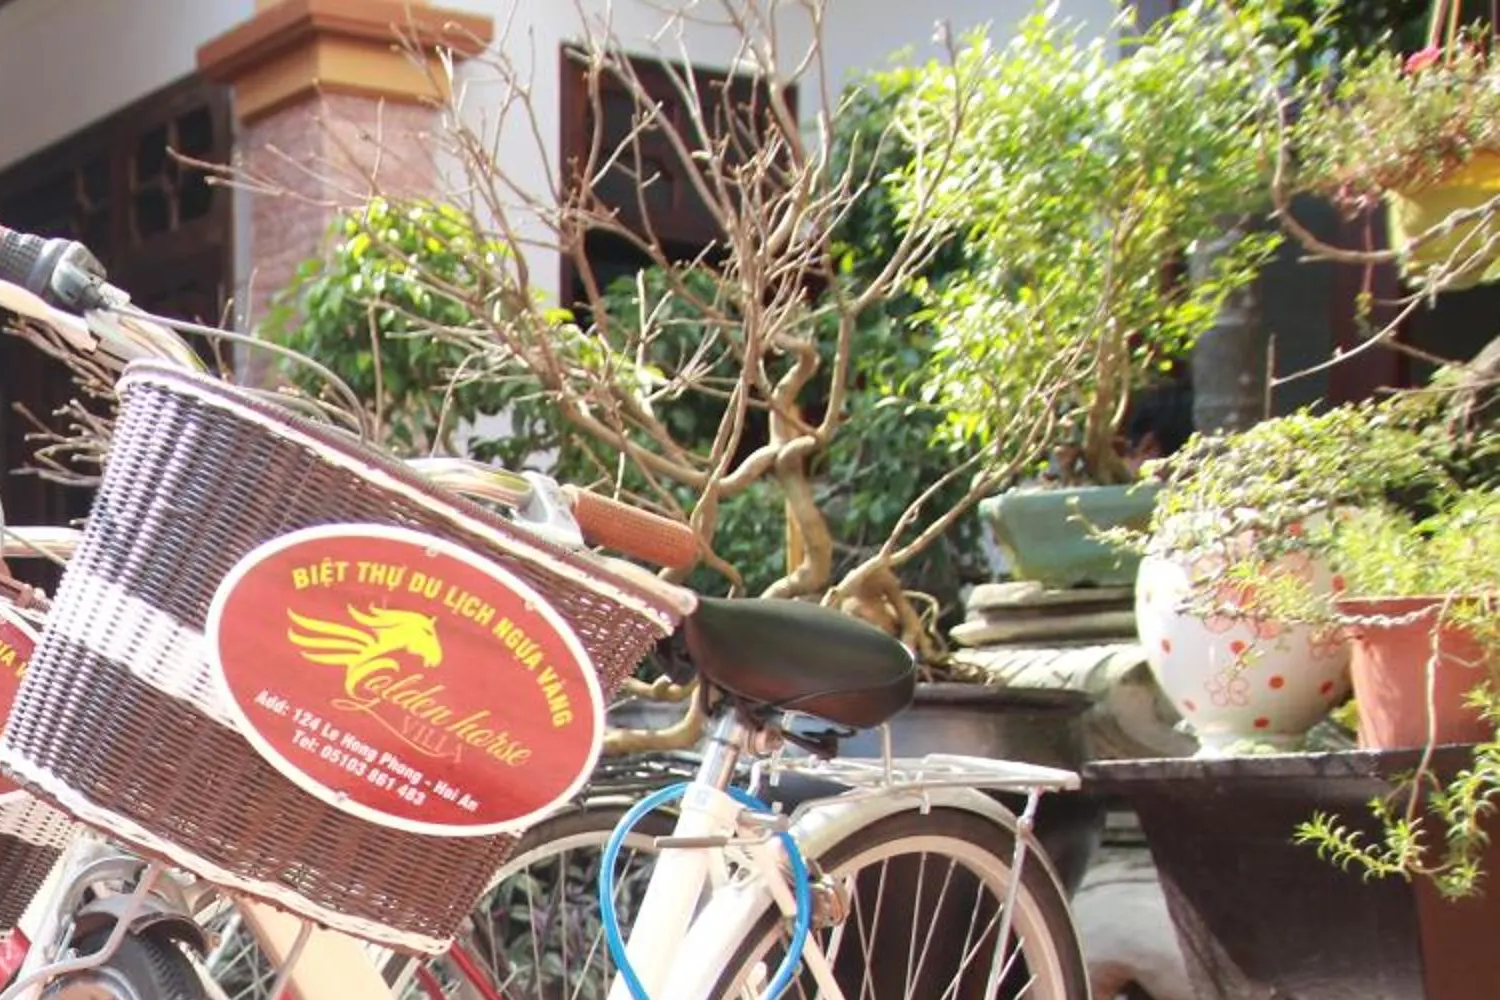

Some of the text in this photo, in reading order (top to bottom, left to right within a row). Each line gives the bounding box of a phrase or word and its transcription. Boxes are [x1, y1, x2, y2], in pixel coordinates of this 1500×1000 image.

[291, 557, 349, 590] BIỆT
[407, 571, 443, 599] DU
[443, 585, 496, 627] LỊCH
[254, 690, 291, 716] Add:
[293, 708, 322, 731] 124
[321, 722, 341, 741] Le
[341, 733, 379, 763] Hong
[379, 751, 424, 785] Phong
[459, 793, 480, 812] An
[345, 659, 533, 768] Golden horse
